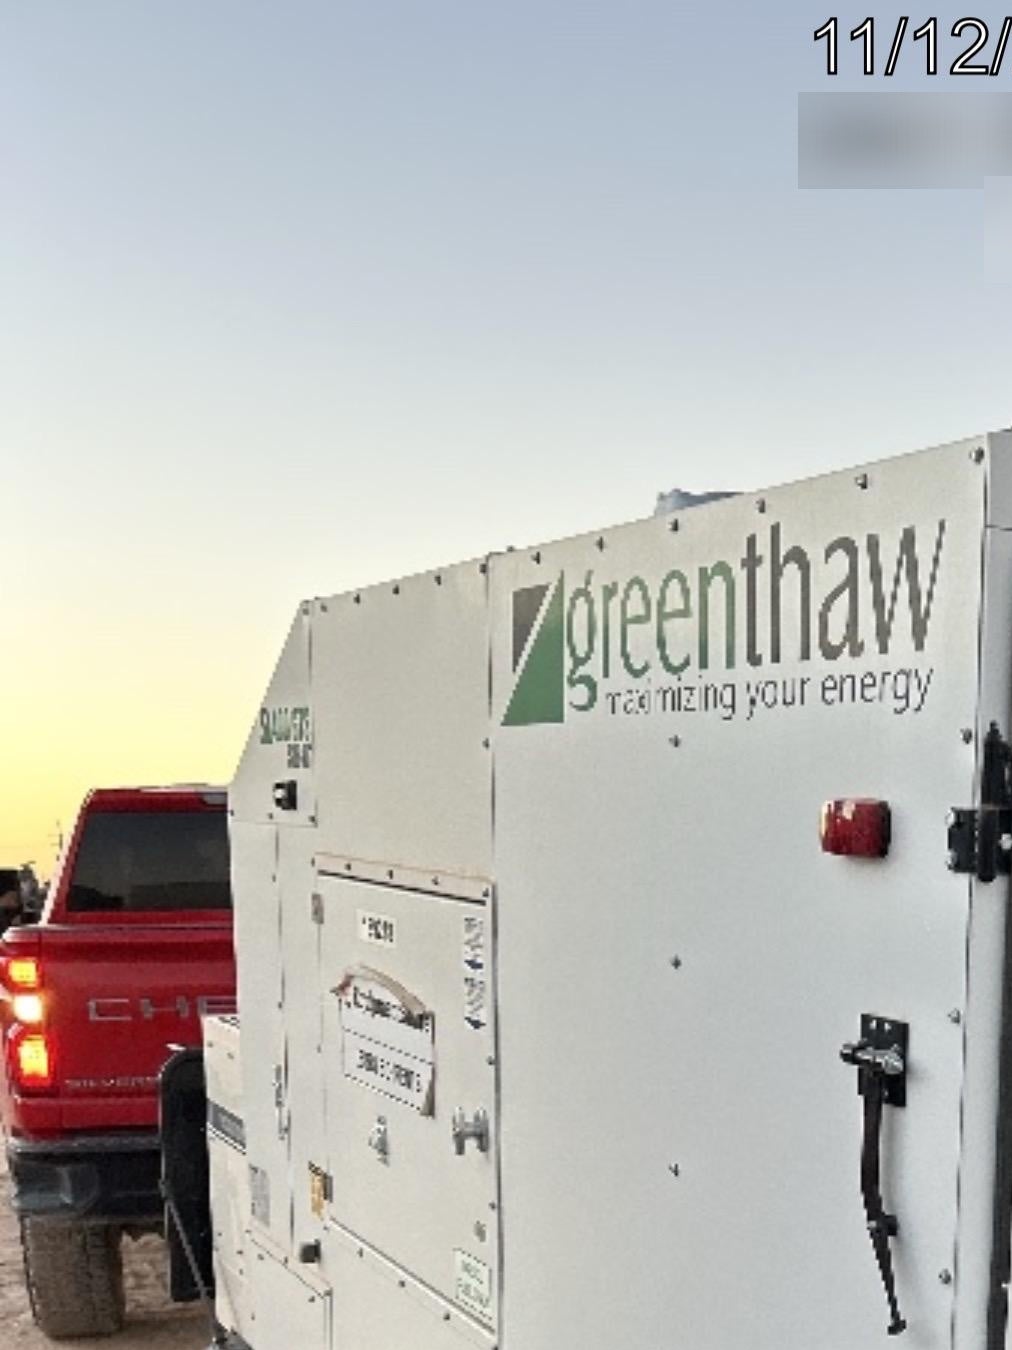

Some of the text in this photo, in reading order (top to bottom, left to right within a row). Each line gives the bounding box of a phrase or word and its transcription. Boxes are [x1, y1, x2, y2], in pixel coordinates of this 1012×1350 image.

[566, 519, 946, 711] greenthaw
[605, 667, 934, 721] maximizing your energy
